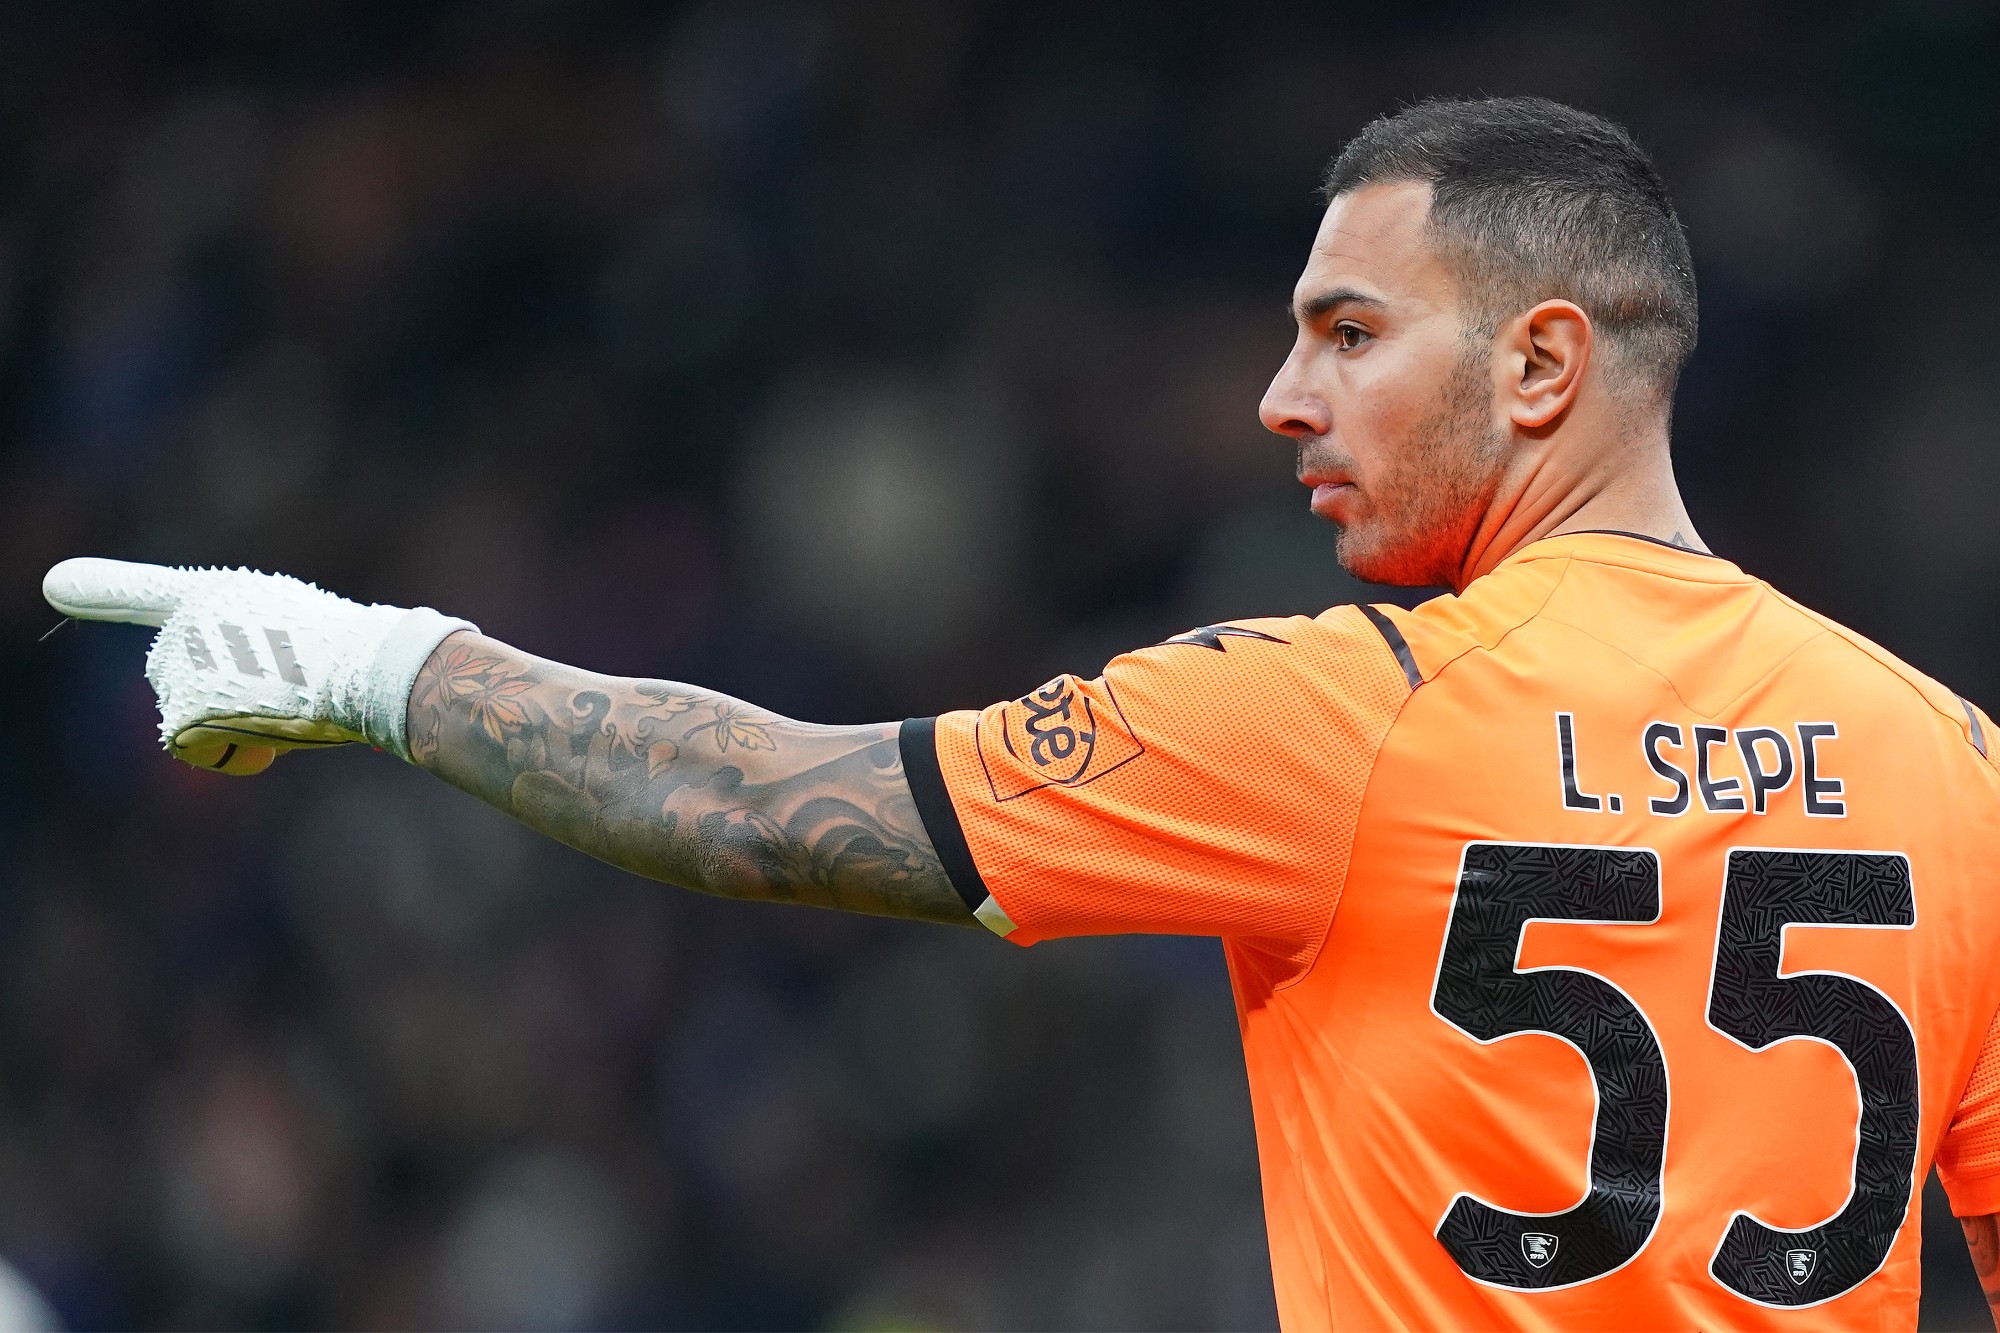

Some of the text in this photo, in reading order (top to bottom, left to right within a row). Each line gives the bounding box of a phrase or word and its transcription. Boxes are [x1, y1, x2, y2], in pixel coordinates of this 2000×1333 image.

[1555, 711, 1847, 818] L. SEPE
[1429, 840, 1920, 1309] 55
